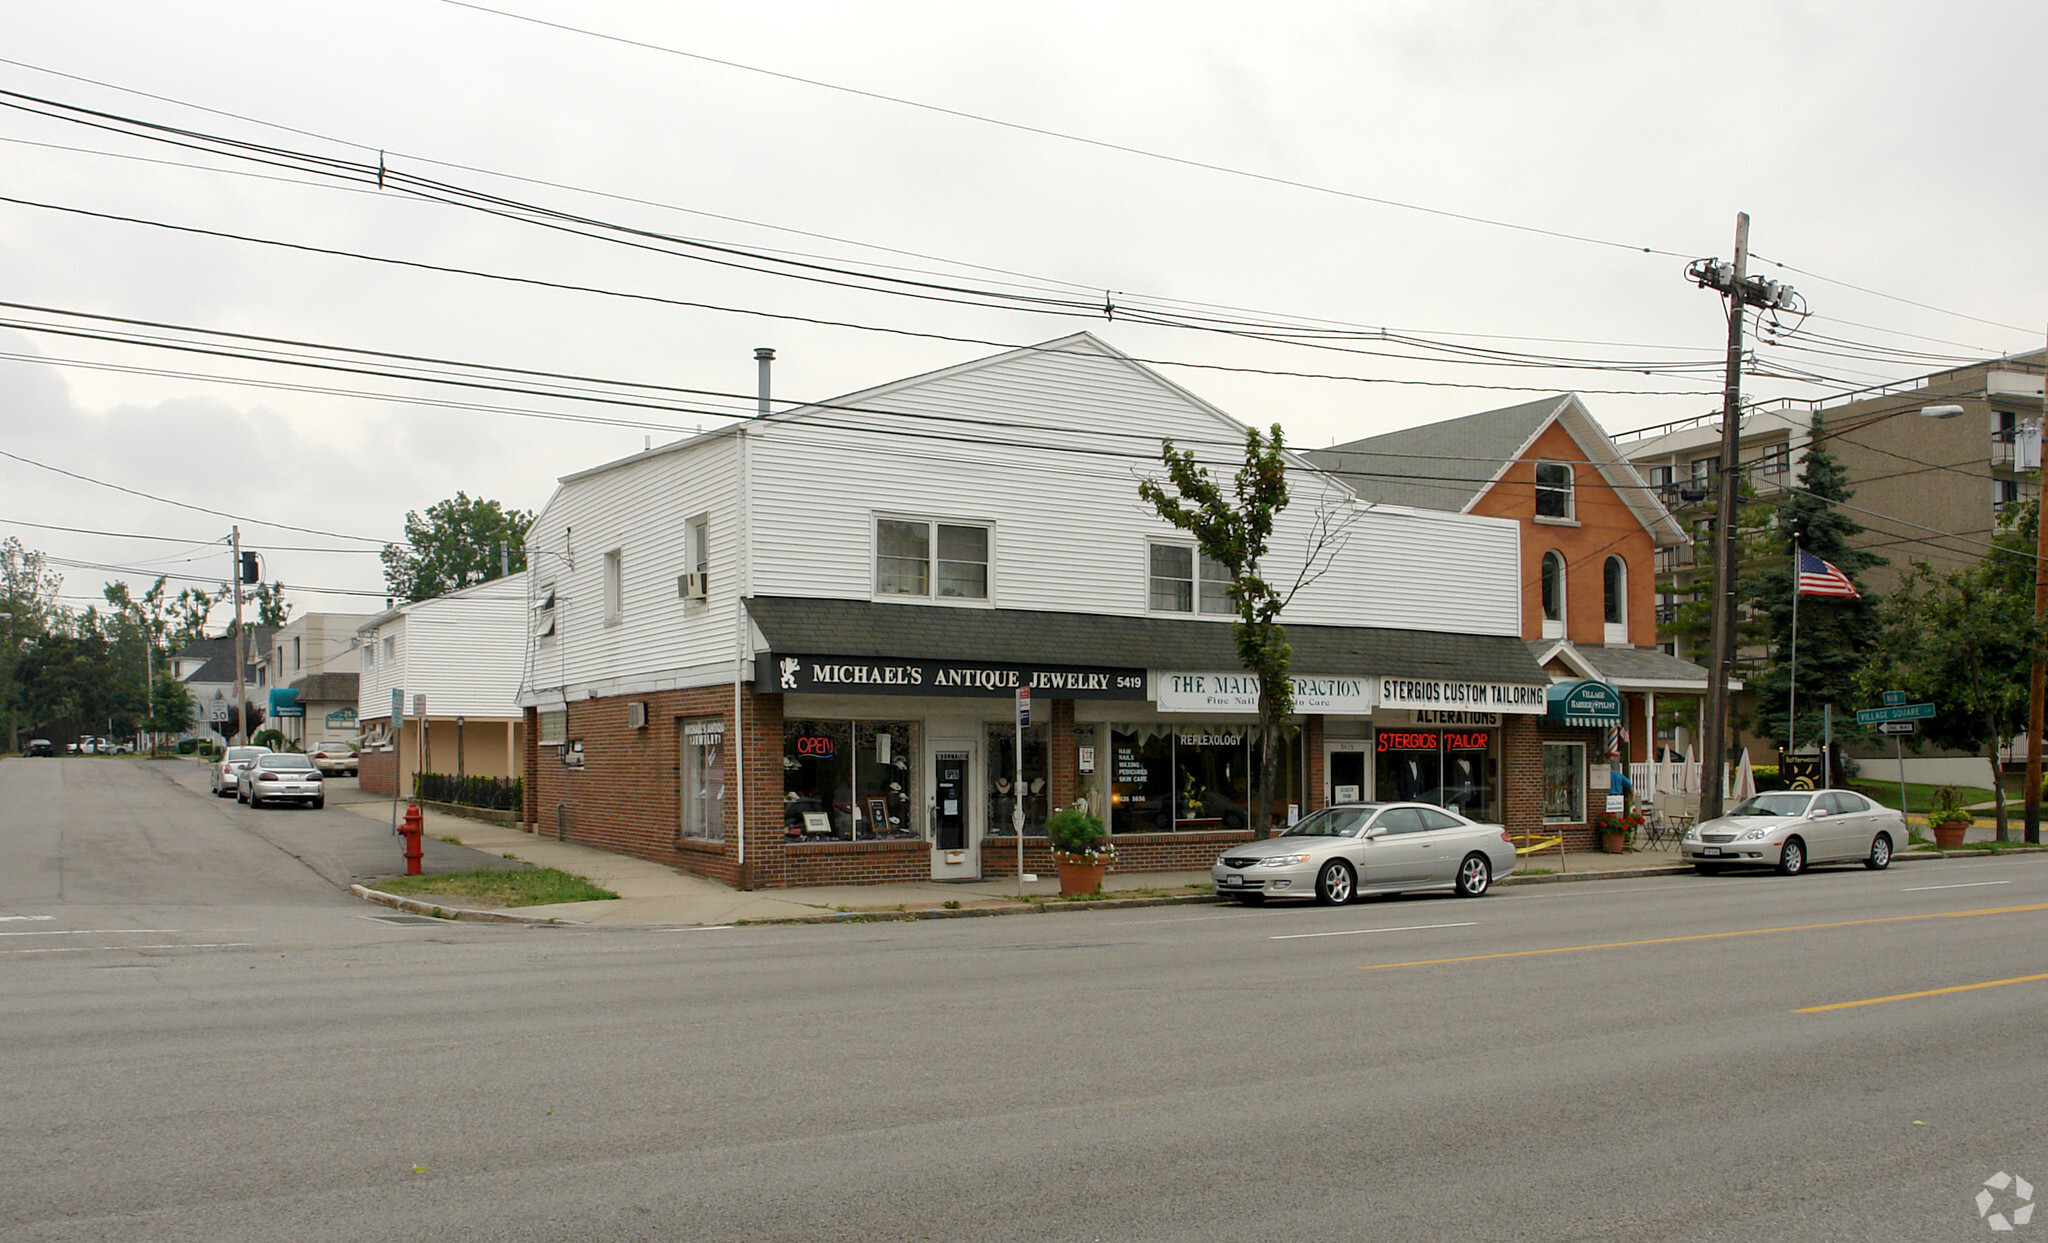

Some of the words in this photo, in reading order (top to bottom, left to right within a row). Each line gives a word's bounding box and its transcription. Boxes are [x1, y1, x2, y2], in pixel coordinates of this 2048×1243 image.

[812, 664, 922, 685] MICHAEL'S
[934, 669, 1019, 691] ANTIQUE
[1029, 671, 1110, 690] JEWELRY
[1117, 676, 1141, 688] 5419
[1171, 675, 1205, 693] THE
[1214, 677, 1260, 694] MAIN
[1288, 679, 1361, 697] RACTION
[1384, 680, 1440, 700] STERGIOS
[1443, 683, 1487, 702] CUSTOM
[1491, 685, 1543, 704] TAILORING
[212, 711, 227, 720] 30
[1417, 711, 1497, 725] ALTERATIONS
[1860, 711, 1888, 720] VILLAGE
[1892, 707, 1920, 717] SQUARE
[797, 737, 833, 754] OPEN
[1180, 734, 1241, 746] REFLEXOLOGY
[1378, 733, 1437, 752] STERGIOS
[1444, 733, 1489, 752] TAILOR
